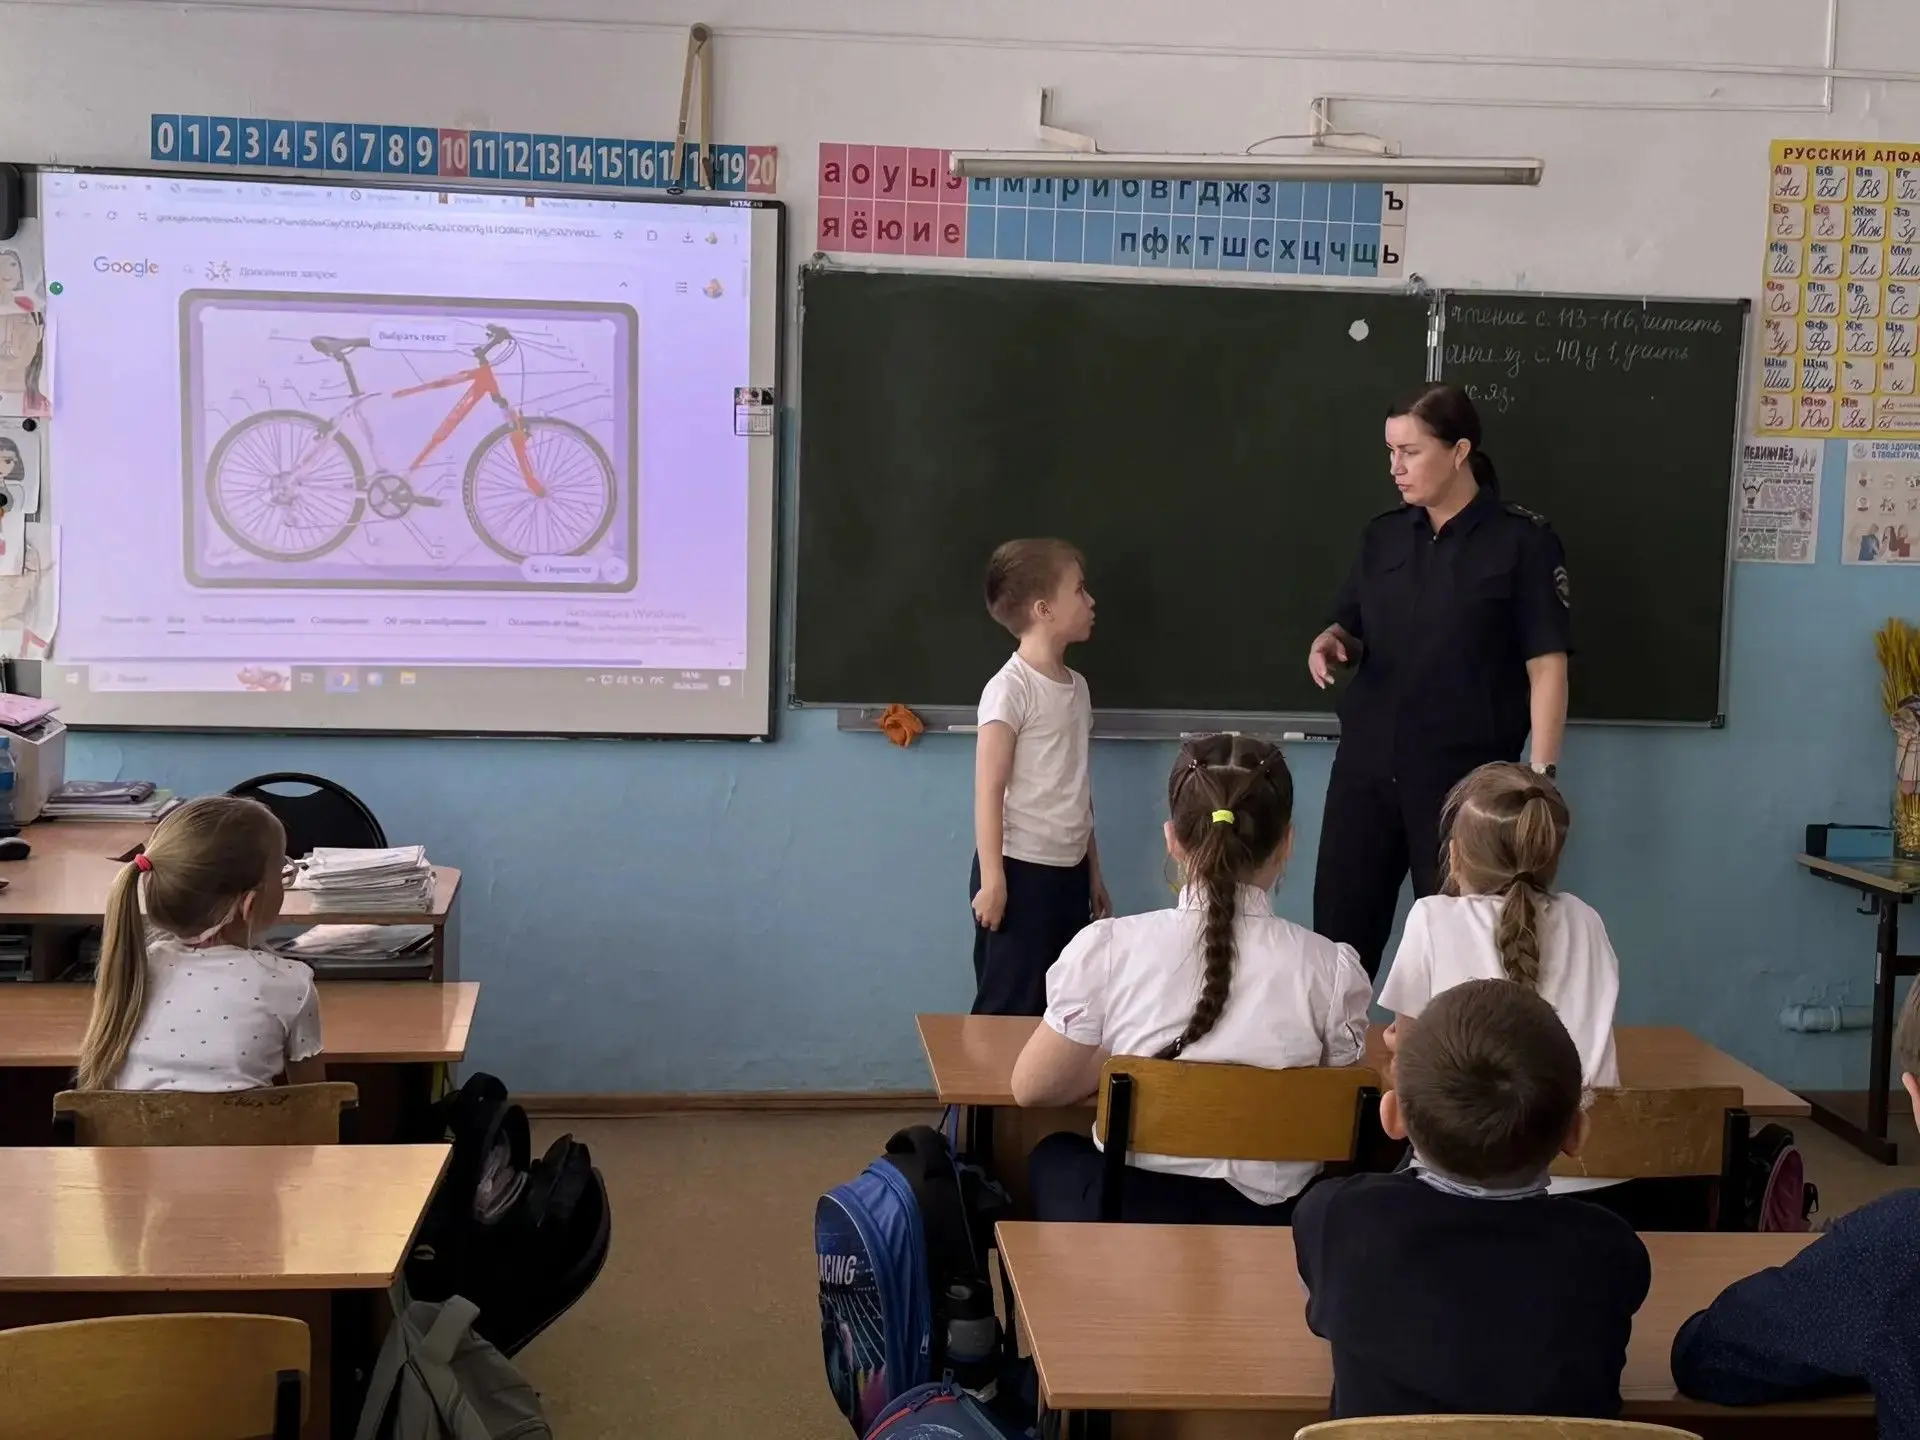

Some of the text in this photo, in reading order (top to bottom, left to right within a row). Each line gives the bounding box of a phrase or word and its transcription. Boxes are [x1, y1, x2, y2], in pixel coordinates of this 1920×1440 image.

[158, 122, 173, 153] 0
[187, 124, 200, 155] 1
[215, 125, 231, 157] 2
[245, 127, 259, 158] 3
[273, 128, 290, 159] 4
[303, 130, 318, 161] 5
[331, 132, 347, 163] 6
[360, 133, 375, 164] 7
[388, 134, 404, 166] 8
[416, 135, 432, 167] 9
[442, 136, 466, 169] 10
[473, 138, 496, 171] 11
[504, 140, 529, 173] 12
[536, 142, 560, 175] 13
[567, 144, 592, 177] 14
[598, 146, 623, 179] 15
[628, 148, 654, 180] 16
[659, 149, 680, 180] 1
[719, 152, 744, 184] 19
[749, 154, 774, 185] 20
[1784, 147, 1920, 162] РУССКИЙ АЛФА
[93, 256, 159, 278] Google
[819, 1254, 857, 1285] ACING
